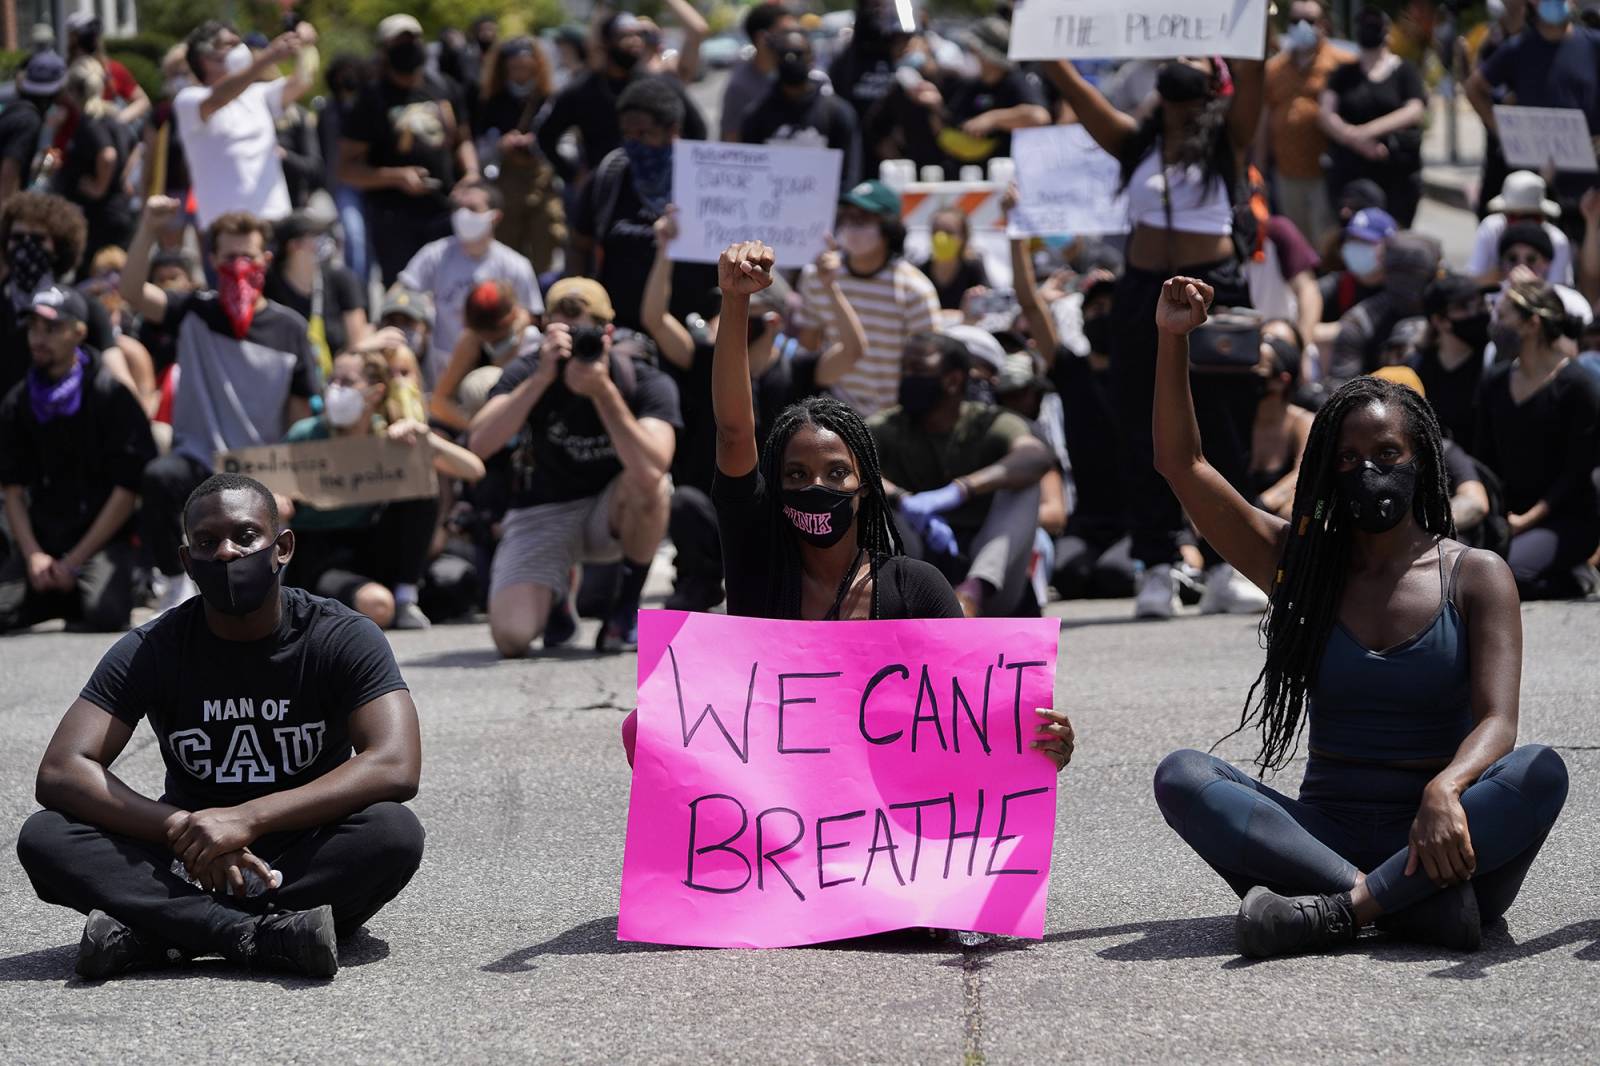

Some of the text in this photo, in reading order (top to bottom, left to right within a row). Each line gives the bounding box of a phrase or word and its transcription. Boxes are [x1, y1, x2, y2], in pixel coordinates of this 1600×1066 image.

[1053, 14, 1098, 47] THE
[203, 697, 291, 722] MAN OF
[667, 644, 1048, 763] WE CAN'T
[168, 720, 327, 783] CAU
[681, 788, 1054, 901] BREATHE
